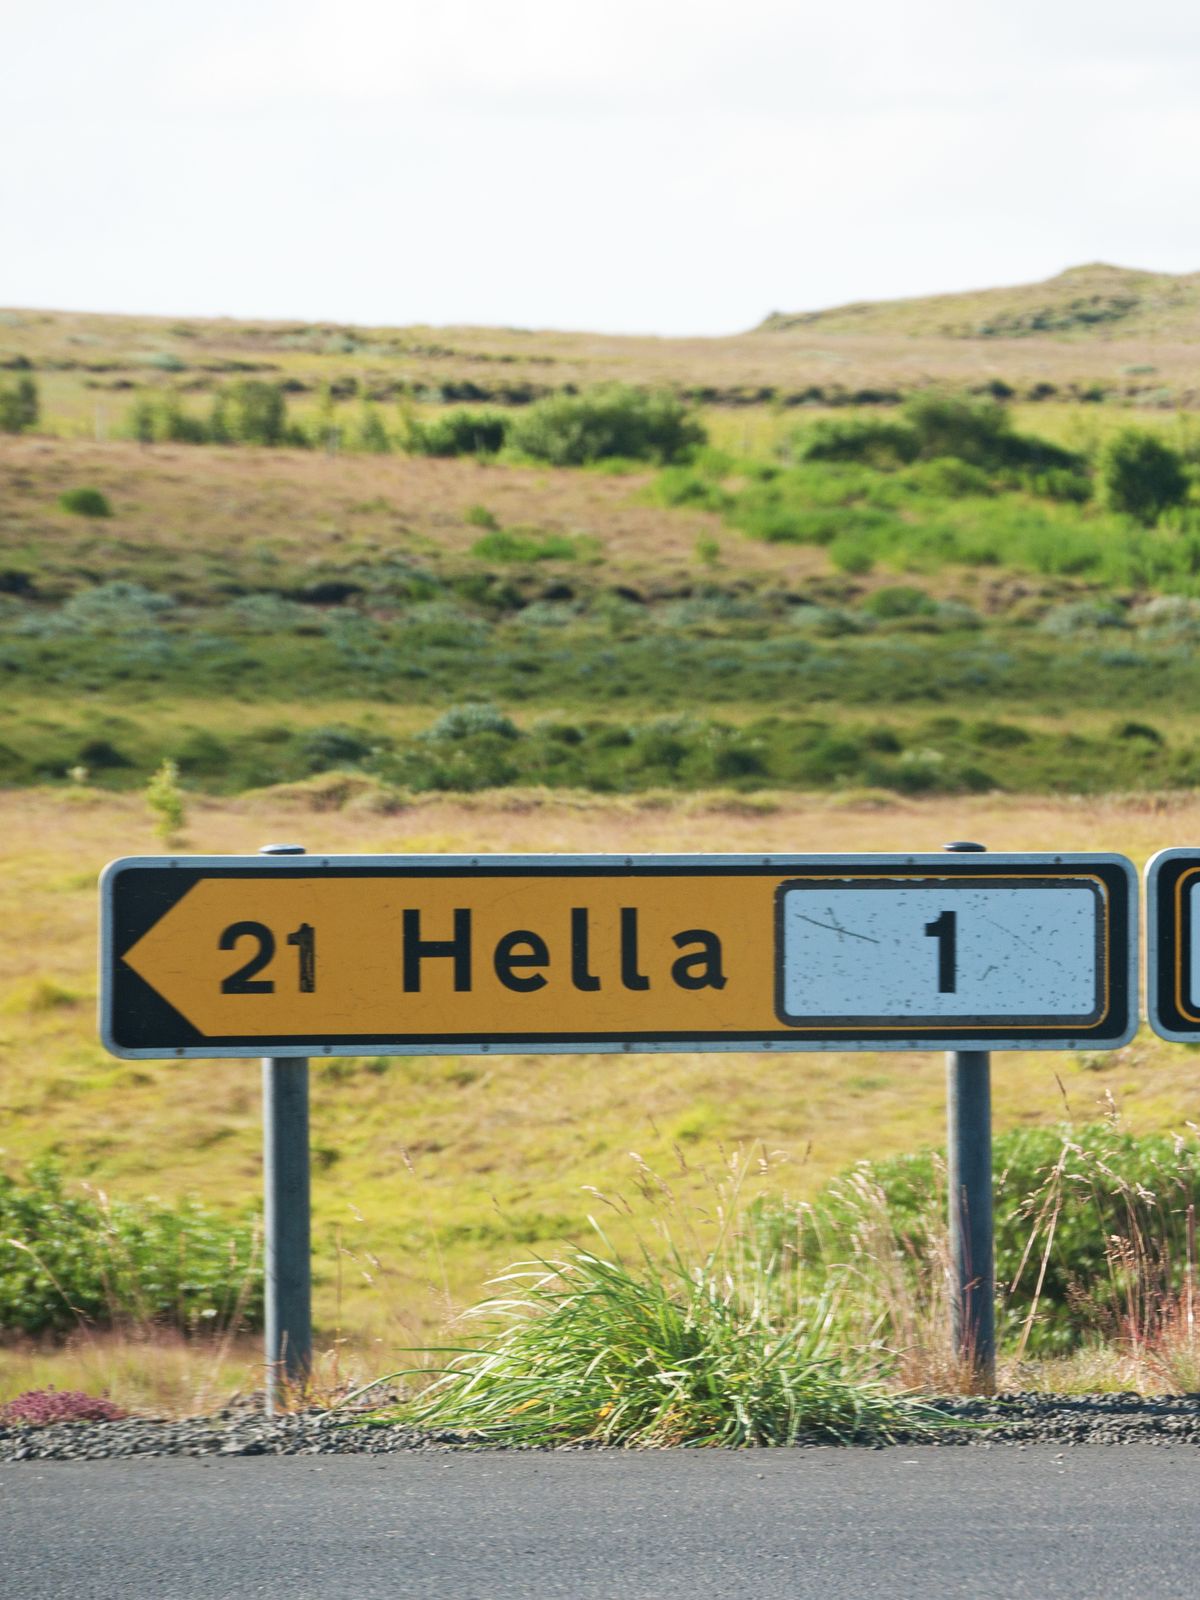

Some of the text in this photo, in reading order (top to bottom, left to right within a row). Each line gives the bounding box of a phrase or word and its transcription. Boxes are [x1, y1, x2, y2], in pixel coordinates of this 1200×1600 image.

[218, 906, 958, 995] 21 Hella 1
